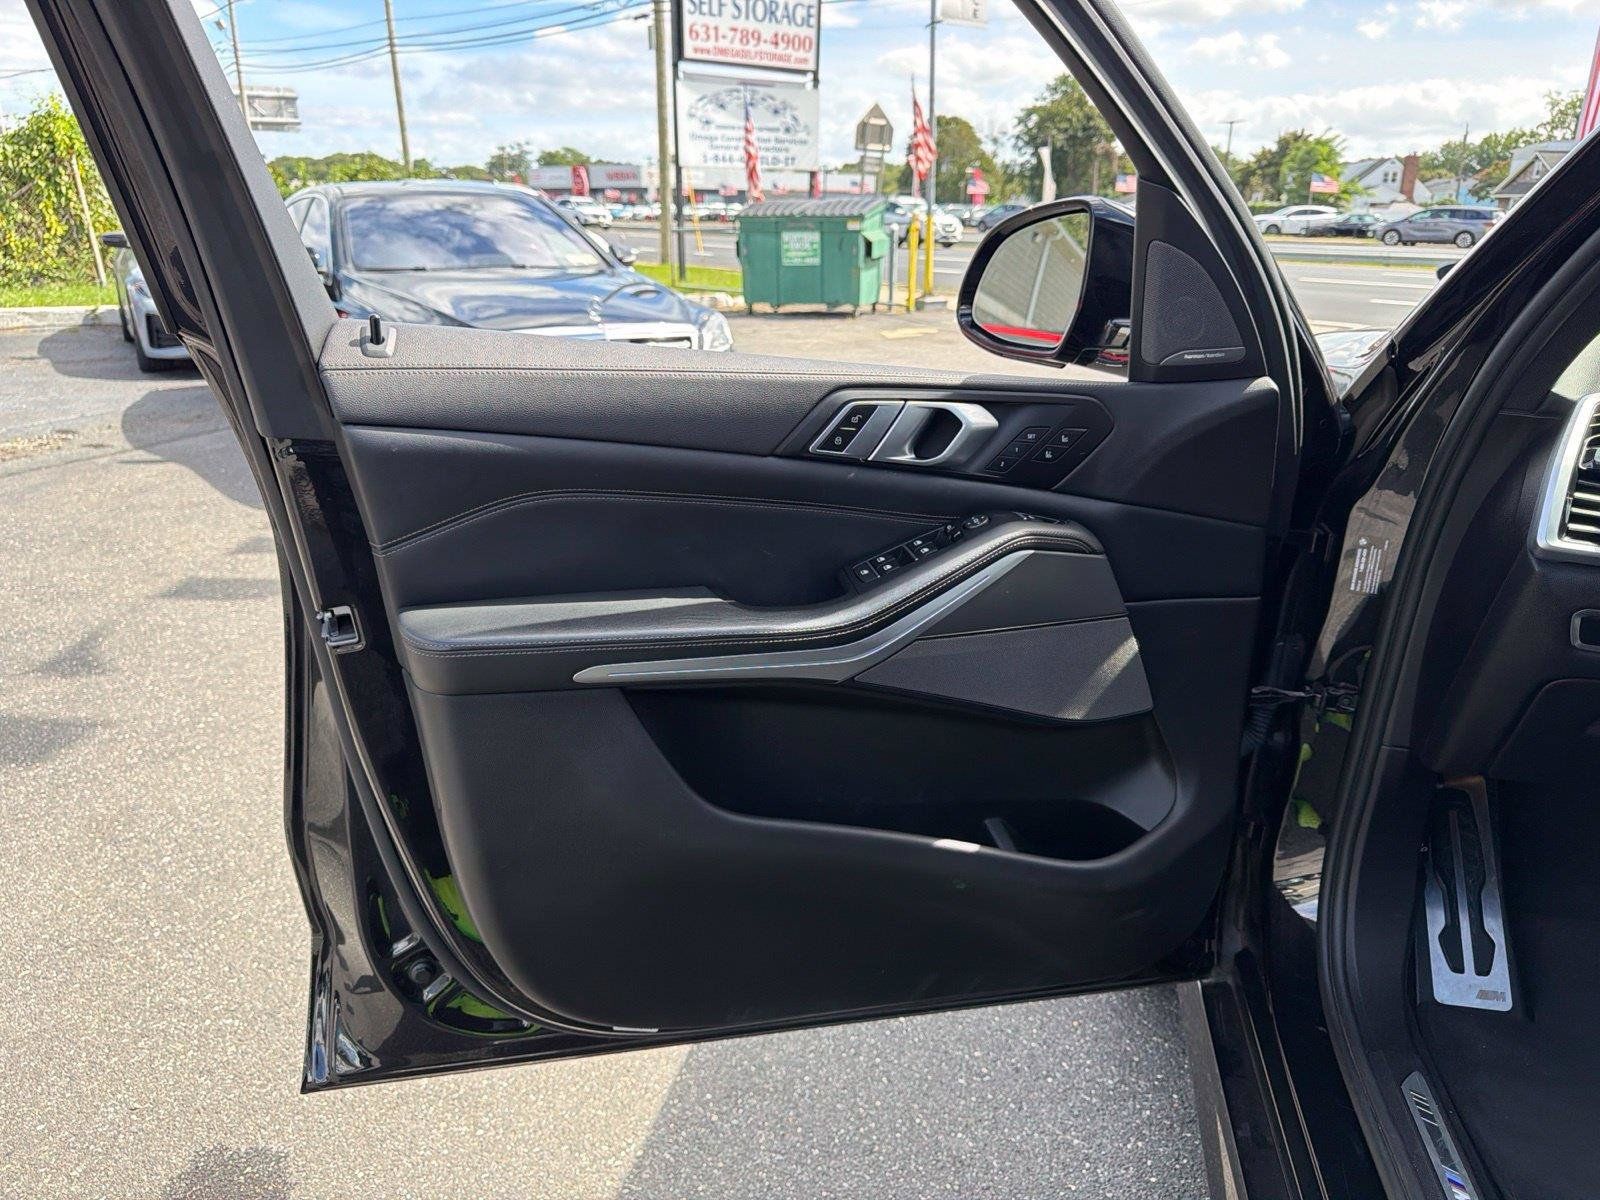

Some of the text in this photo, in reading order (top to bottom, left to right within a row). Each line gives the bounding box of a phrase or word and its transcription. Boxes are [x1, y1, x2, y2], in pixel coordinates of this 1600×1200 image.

[688, 0, 815, 28] SELF STORAGE
[688, 23, 813, 53] 631-789-4900
